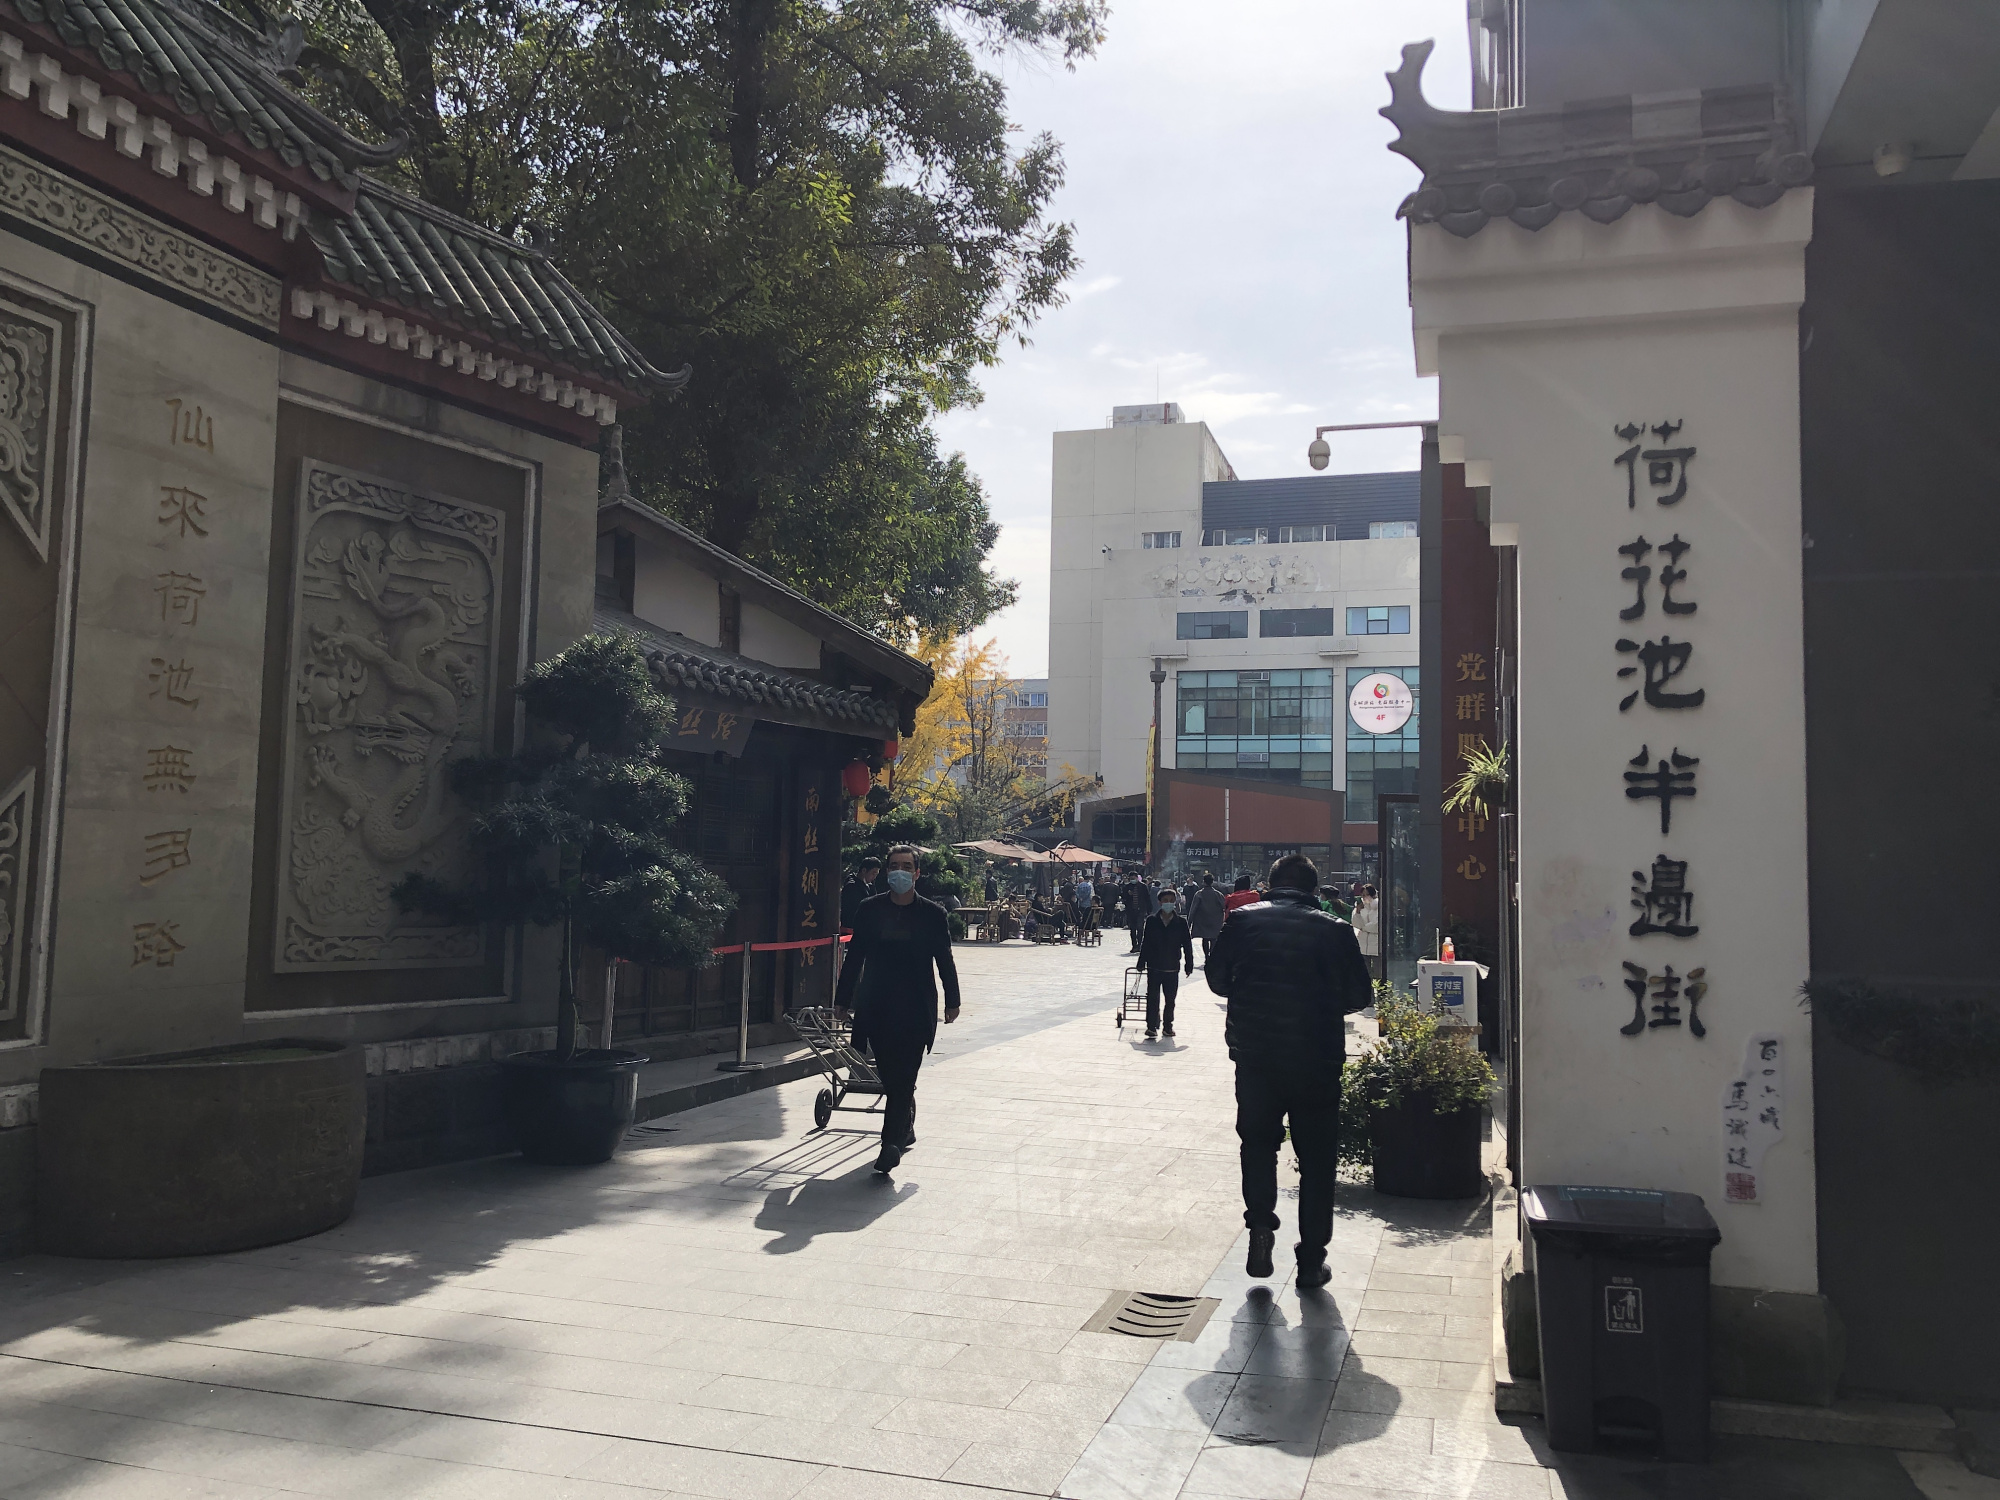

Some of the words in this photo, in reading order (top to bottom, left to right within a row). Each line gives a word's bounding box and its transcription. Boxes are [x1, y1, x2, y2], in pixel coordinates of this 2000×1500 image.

[1455, 652, 1488, 881] 党群服中心
[1614, 417, 1708, 1039] 荷花池半邊街
[1186, 847, 1220, 858] 东方道具
[1434, 980, 1462, 990] 支付宝
